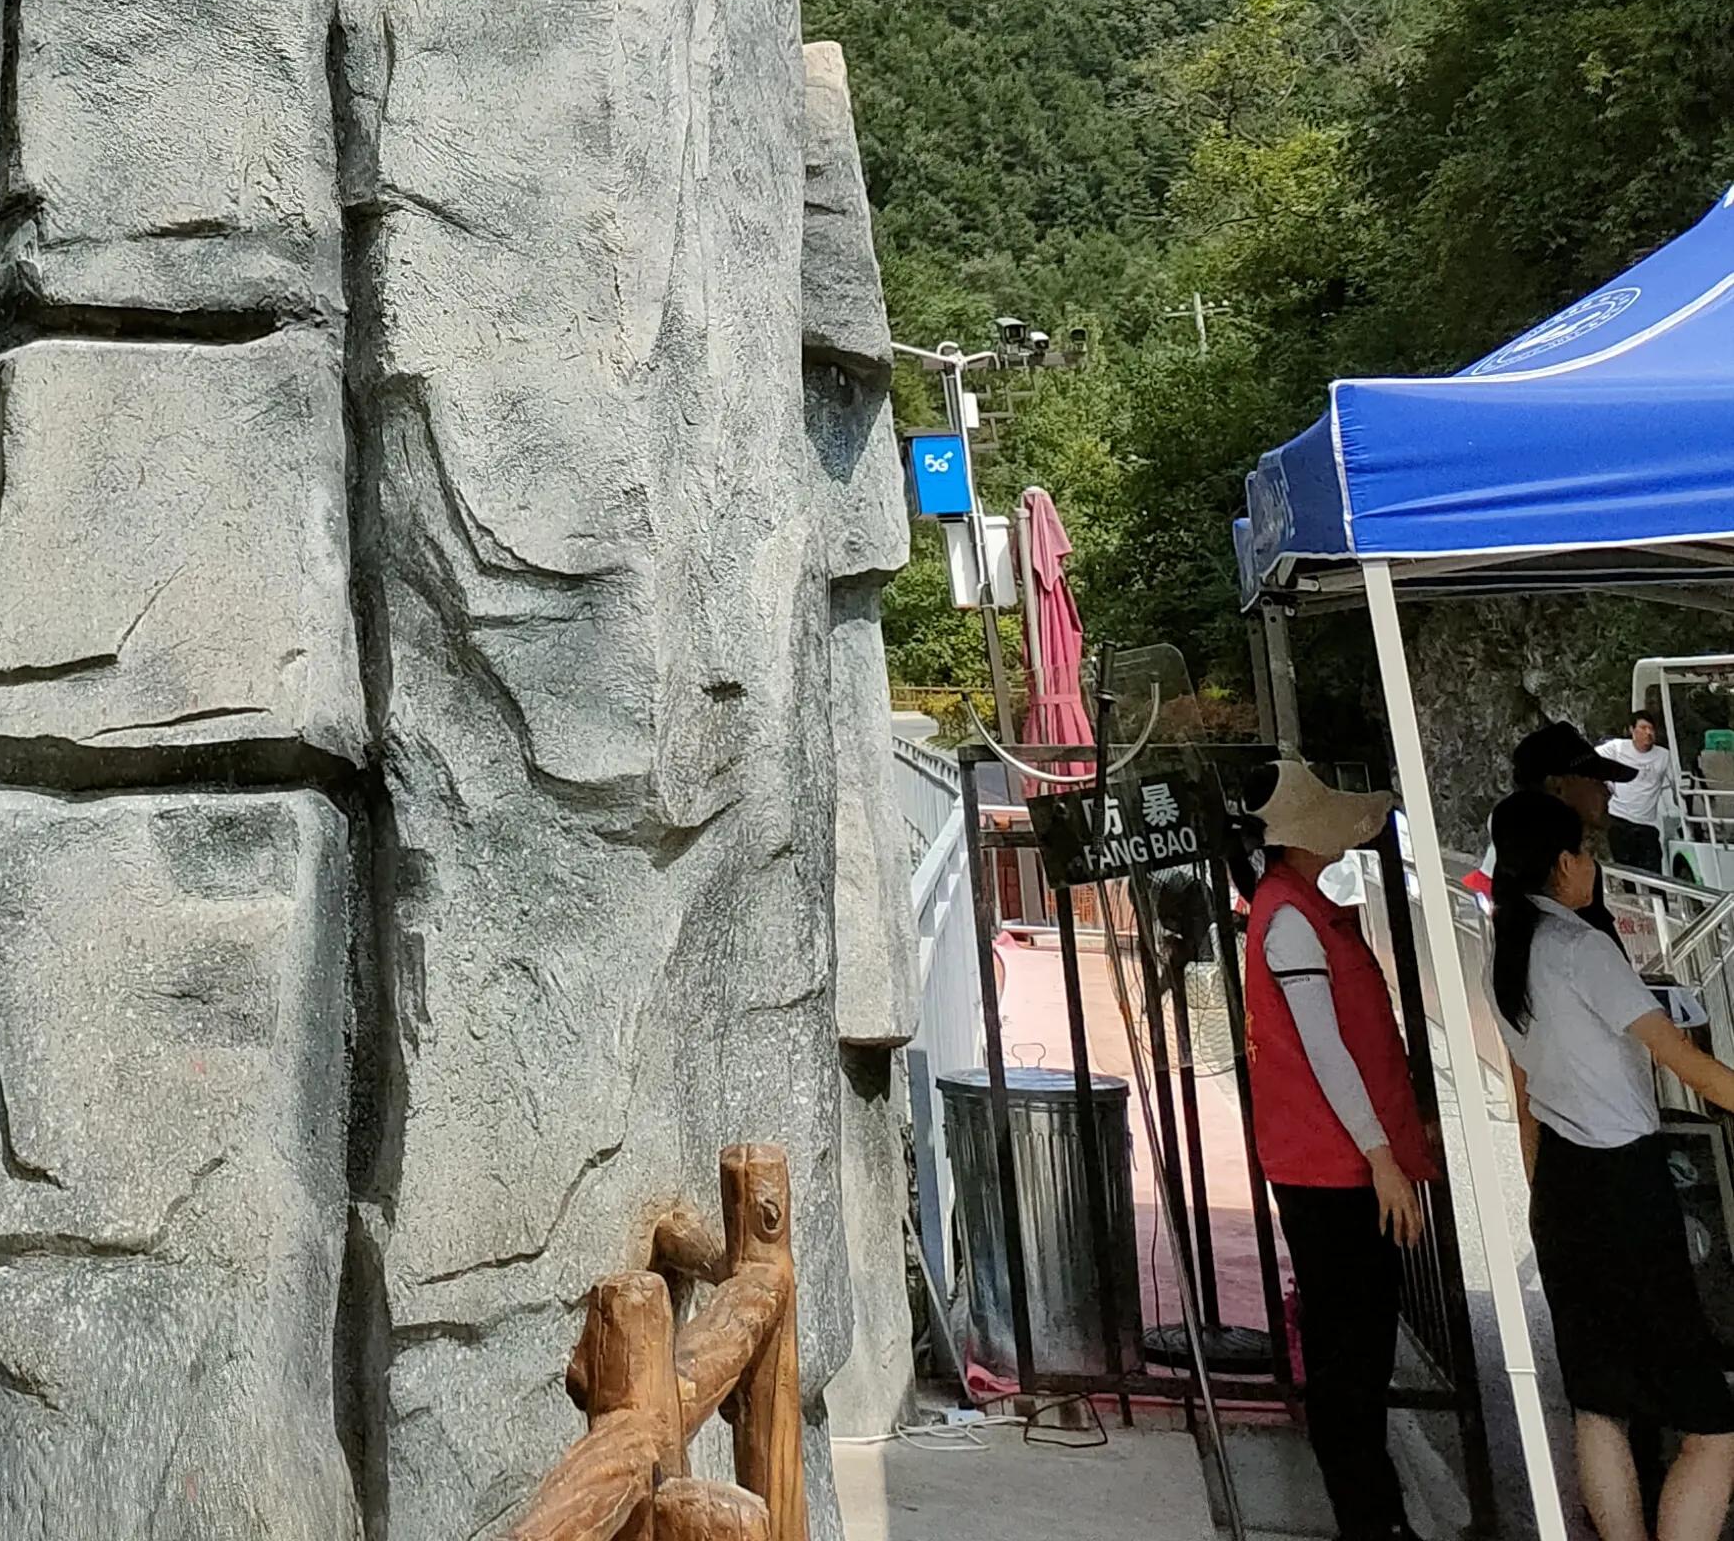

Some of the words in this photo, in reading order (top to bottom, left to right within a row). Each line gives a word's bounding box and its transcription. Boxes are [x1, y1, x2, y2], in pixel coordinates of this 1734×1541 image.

[1081, 782, 1180, 836] 防暴
[1083, 835, 1149, 871] FANG
[1150, 826, 1198, 859] BAO
